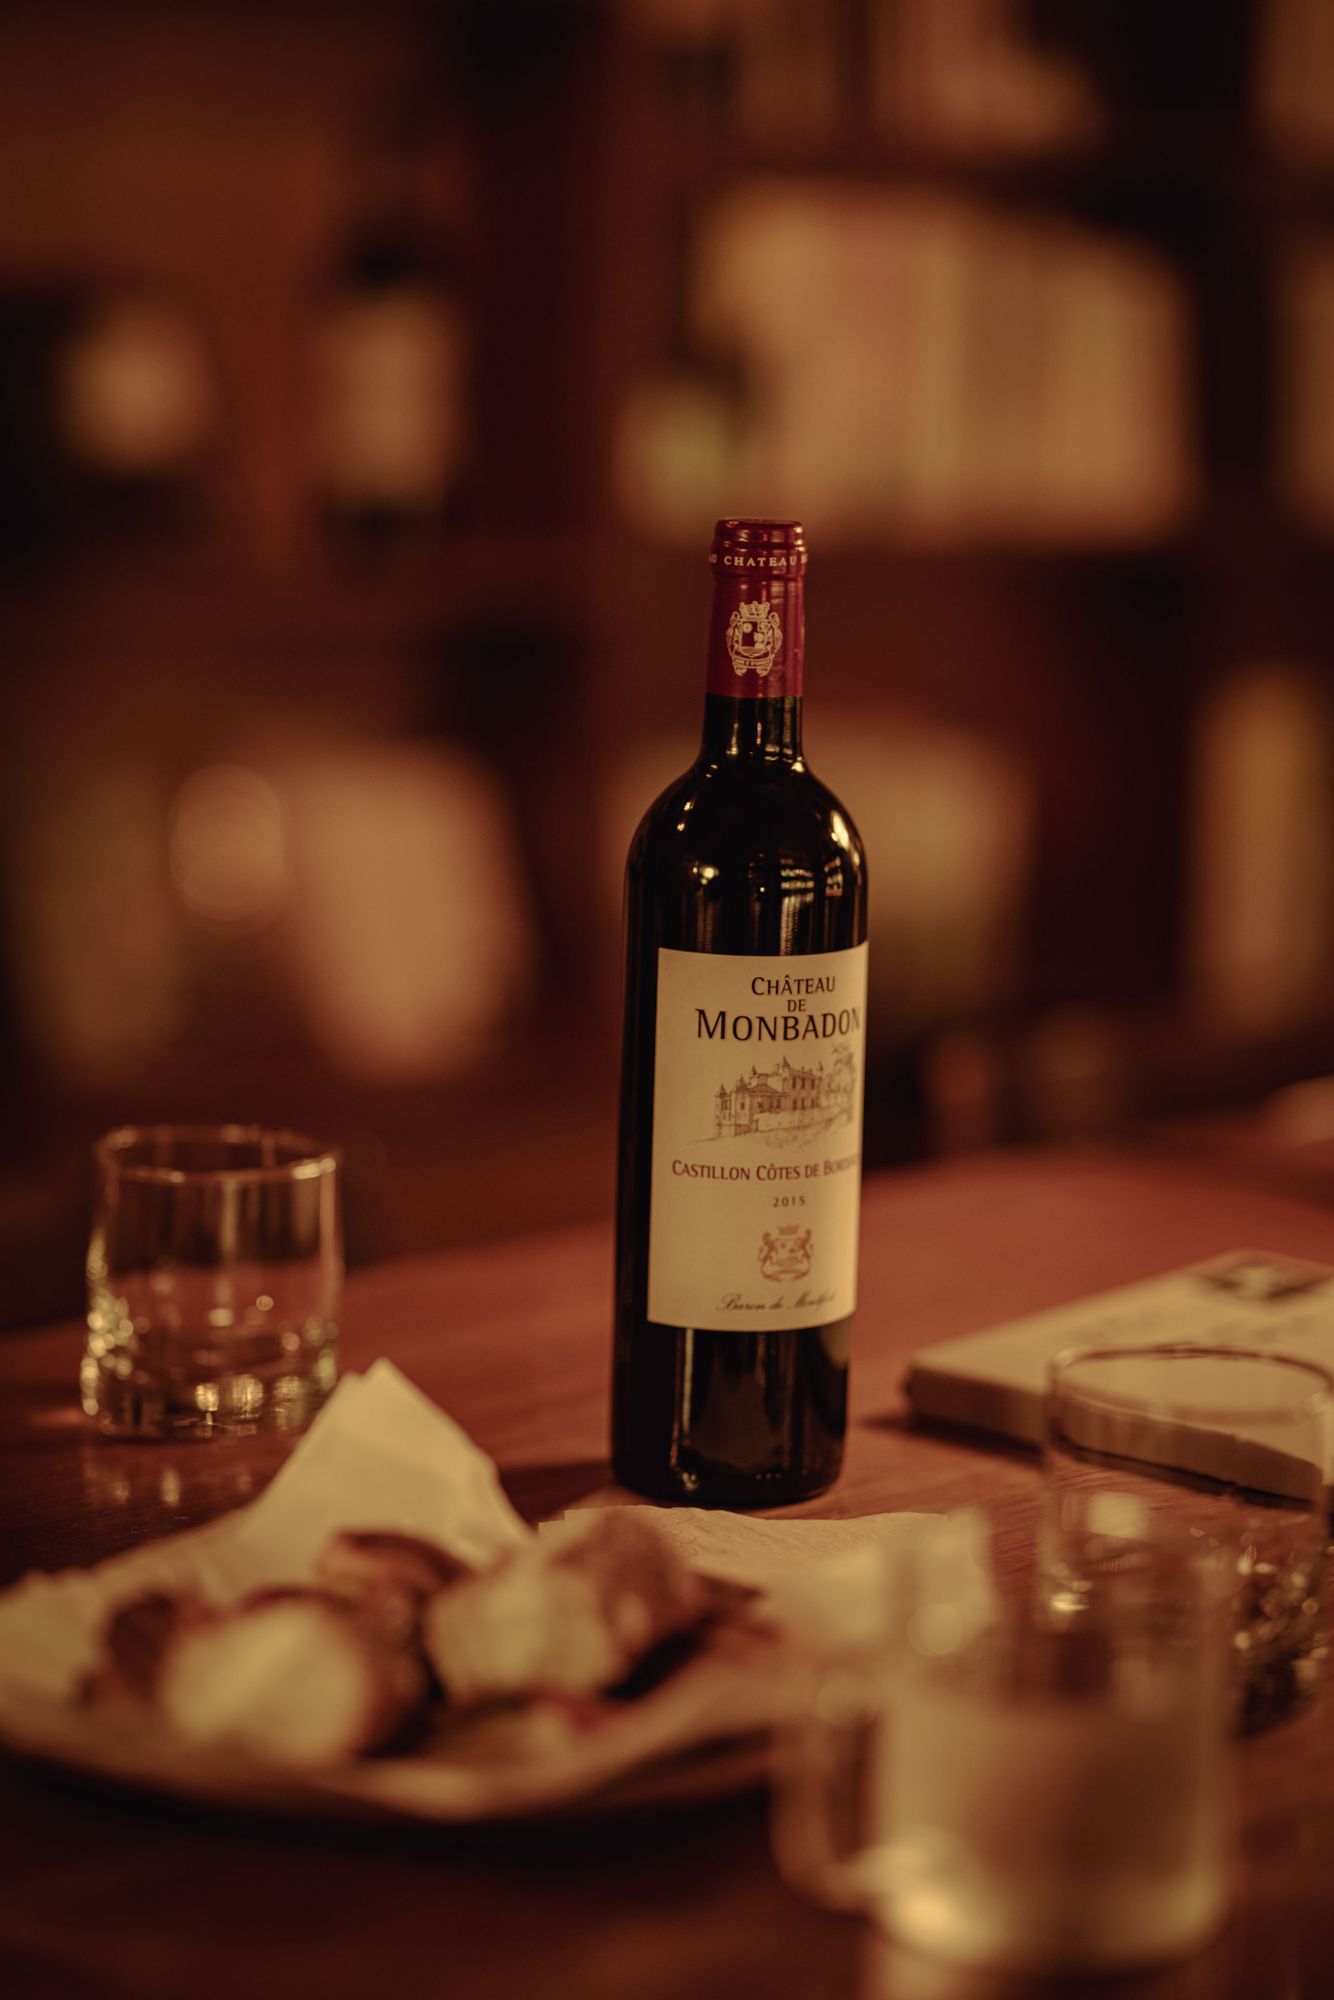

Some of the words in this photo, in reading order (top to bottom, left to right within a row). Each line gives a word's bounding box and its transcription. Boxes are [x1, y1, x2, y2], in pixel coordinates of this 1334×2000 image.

[724, 555, 797, 567] CHATEAU
[751, 974, 836, 996] CHÂTEAU
[787, 999, 806, 1013] DE
[695, 1006, 860, 1041] MONBADON
[672, 1160, 750, 1181] CASTILLON
[756, 1163, 801, 1181] CÔTES
[804, 1163, 820, 1179] DE
[772, 1196, 806, 1208] 2015
